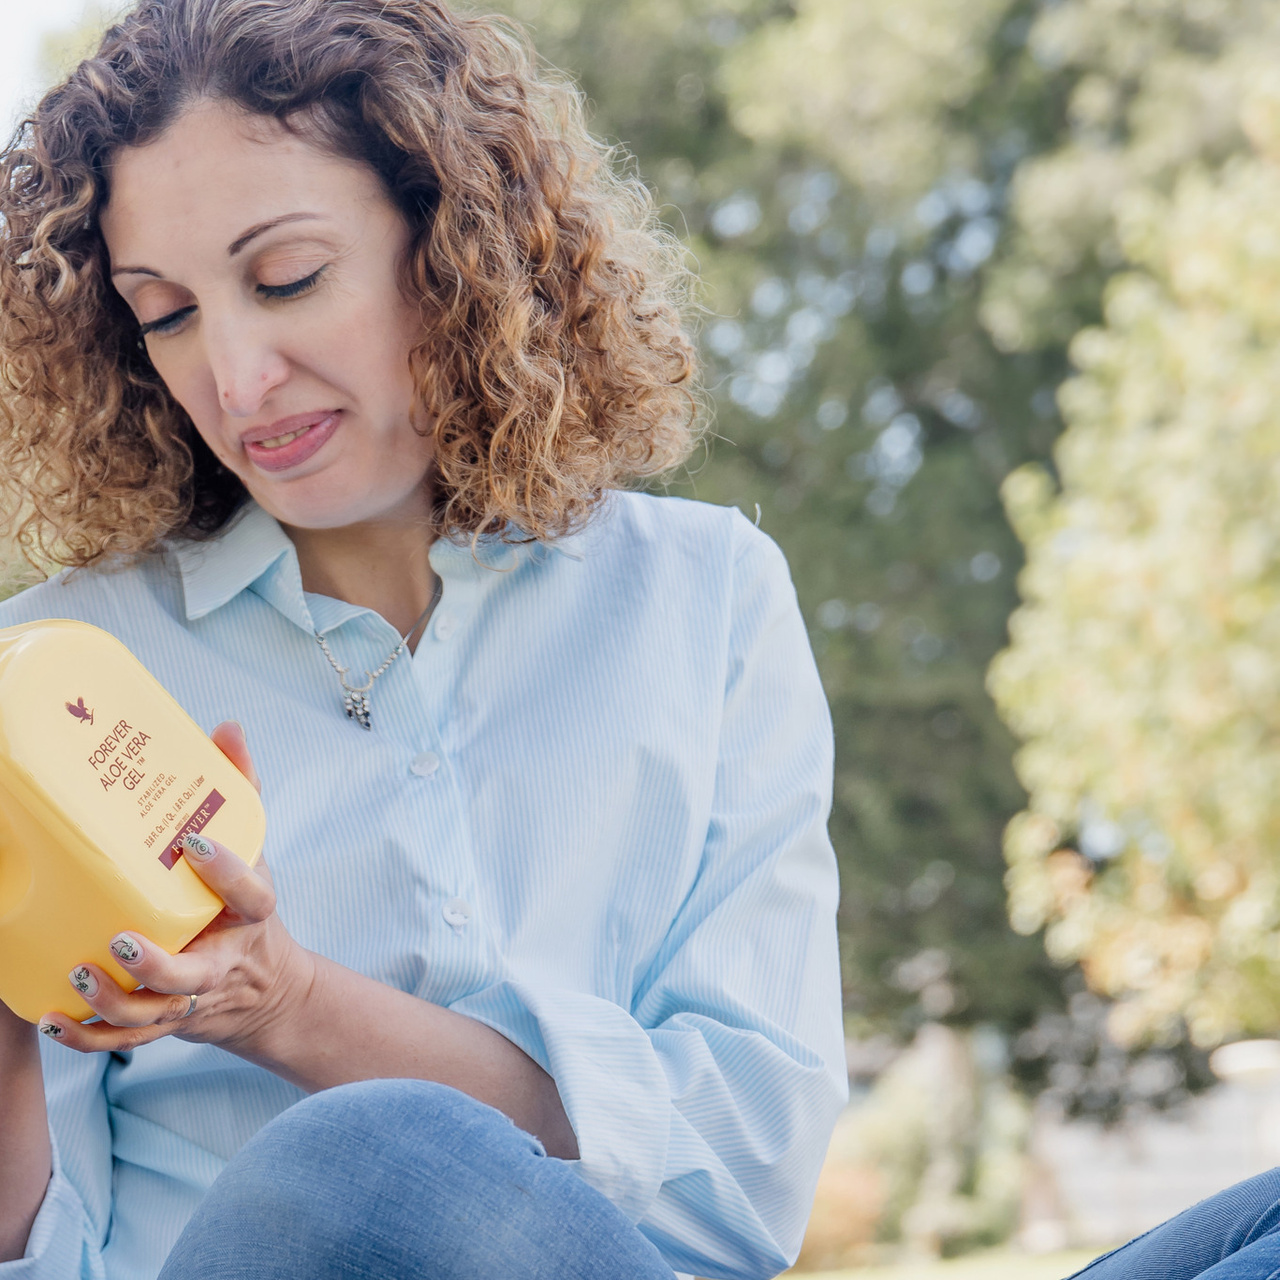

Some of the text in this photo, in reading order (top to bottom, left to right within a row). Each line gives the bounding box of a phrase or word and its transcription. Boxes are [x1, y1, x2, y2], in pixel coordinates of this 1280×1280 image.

[88, 719, 132, 770] FOREVER
[100, 731, 151, 792] ALOE VERA
[123, 767, 145, 791] GEL
[138, 773, 165, 806] STABILIZED
[140, 774, 177, 818] ALOE VERA GEL
